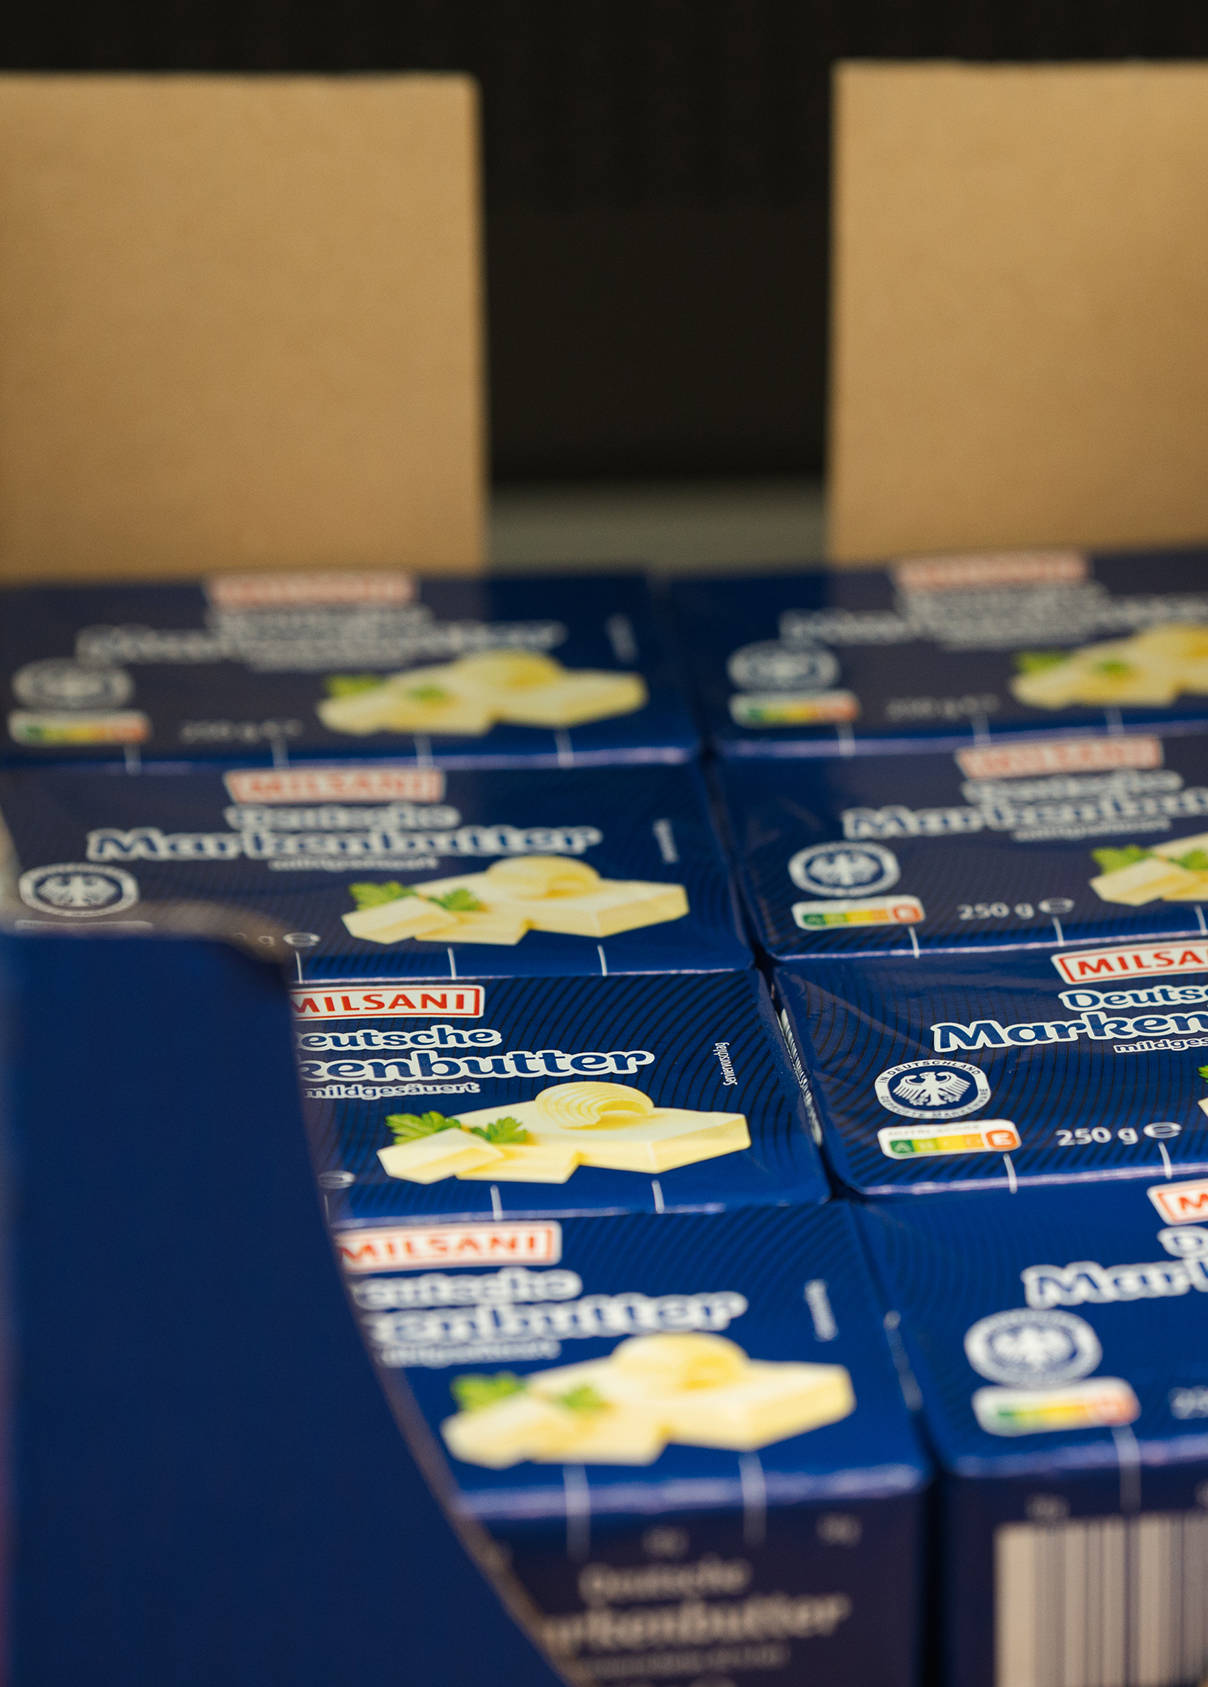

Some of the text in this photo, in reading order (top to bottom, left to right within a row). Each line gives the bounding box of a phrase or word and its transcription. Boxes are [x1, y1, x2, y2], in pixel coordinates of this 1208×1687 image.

[299, 1024, 502, 1051] eutsche
[1056, 1127, 1139, 1146] 250 g
